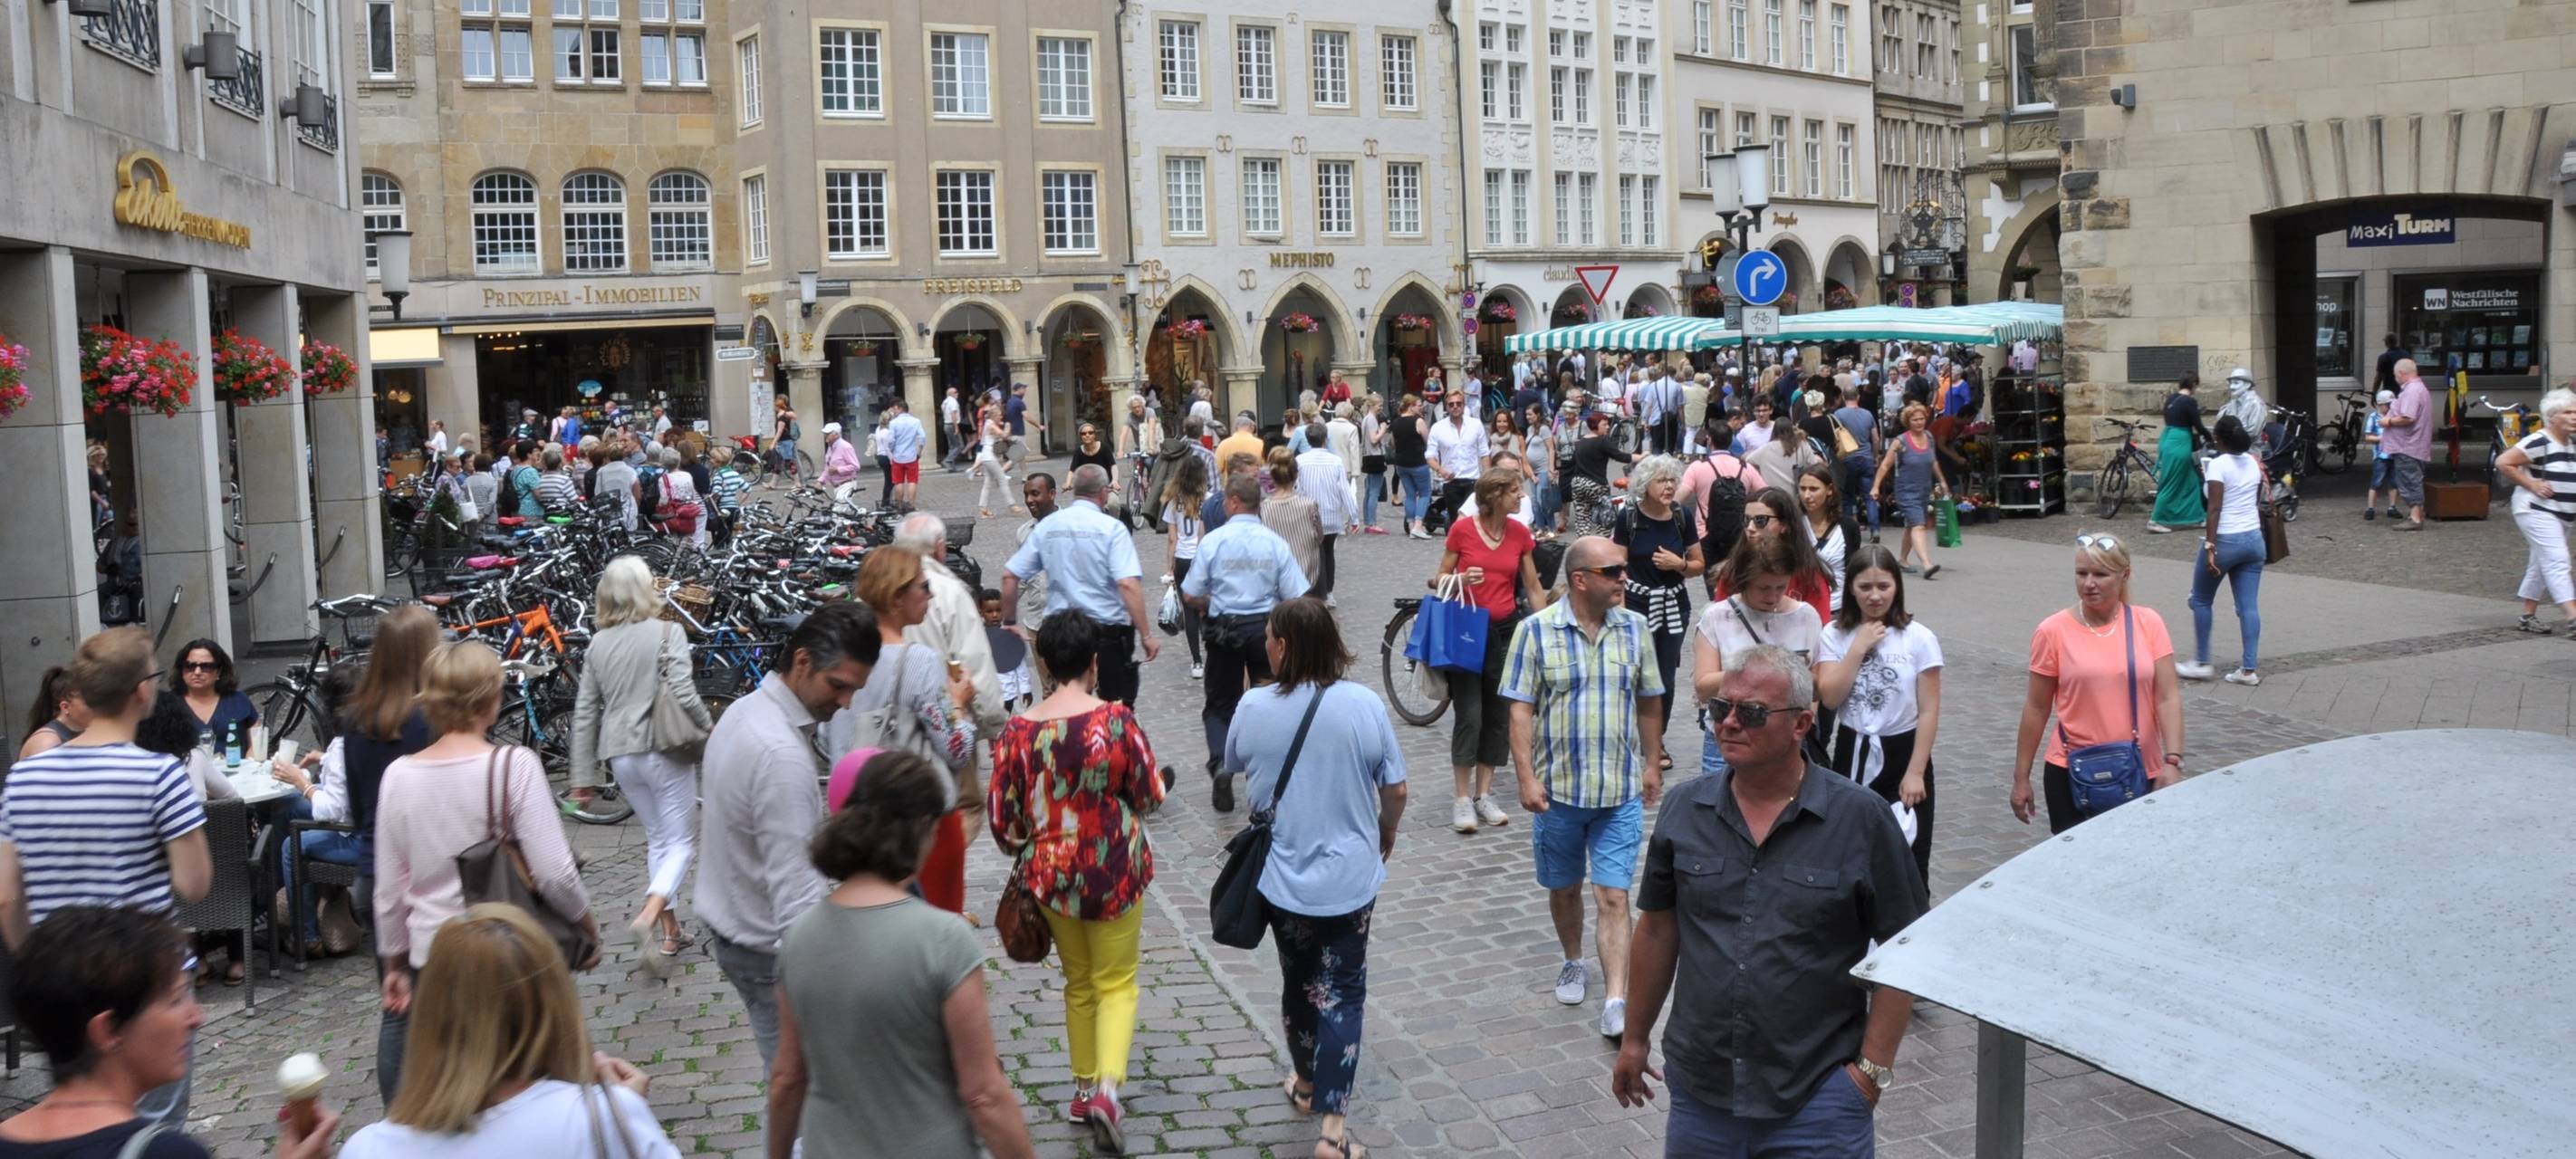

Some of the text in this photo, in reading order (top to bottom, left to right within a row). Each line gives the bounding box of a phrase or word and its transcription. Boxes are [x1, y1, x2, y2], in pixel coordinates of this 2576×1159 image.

[2349, 214, 2451, 240] Maxi TURM
[1270, 252, 1335, 268] MEPHISTO
[924, 278, 1023, 295] FREISFELD
[2451, 289, 2519, 299] Westfälische
[2426, 298, 2446, 308] WN
[2451, 298, 2518, 308] Nachrichten
